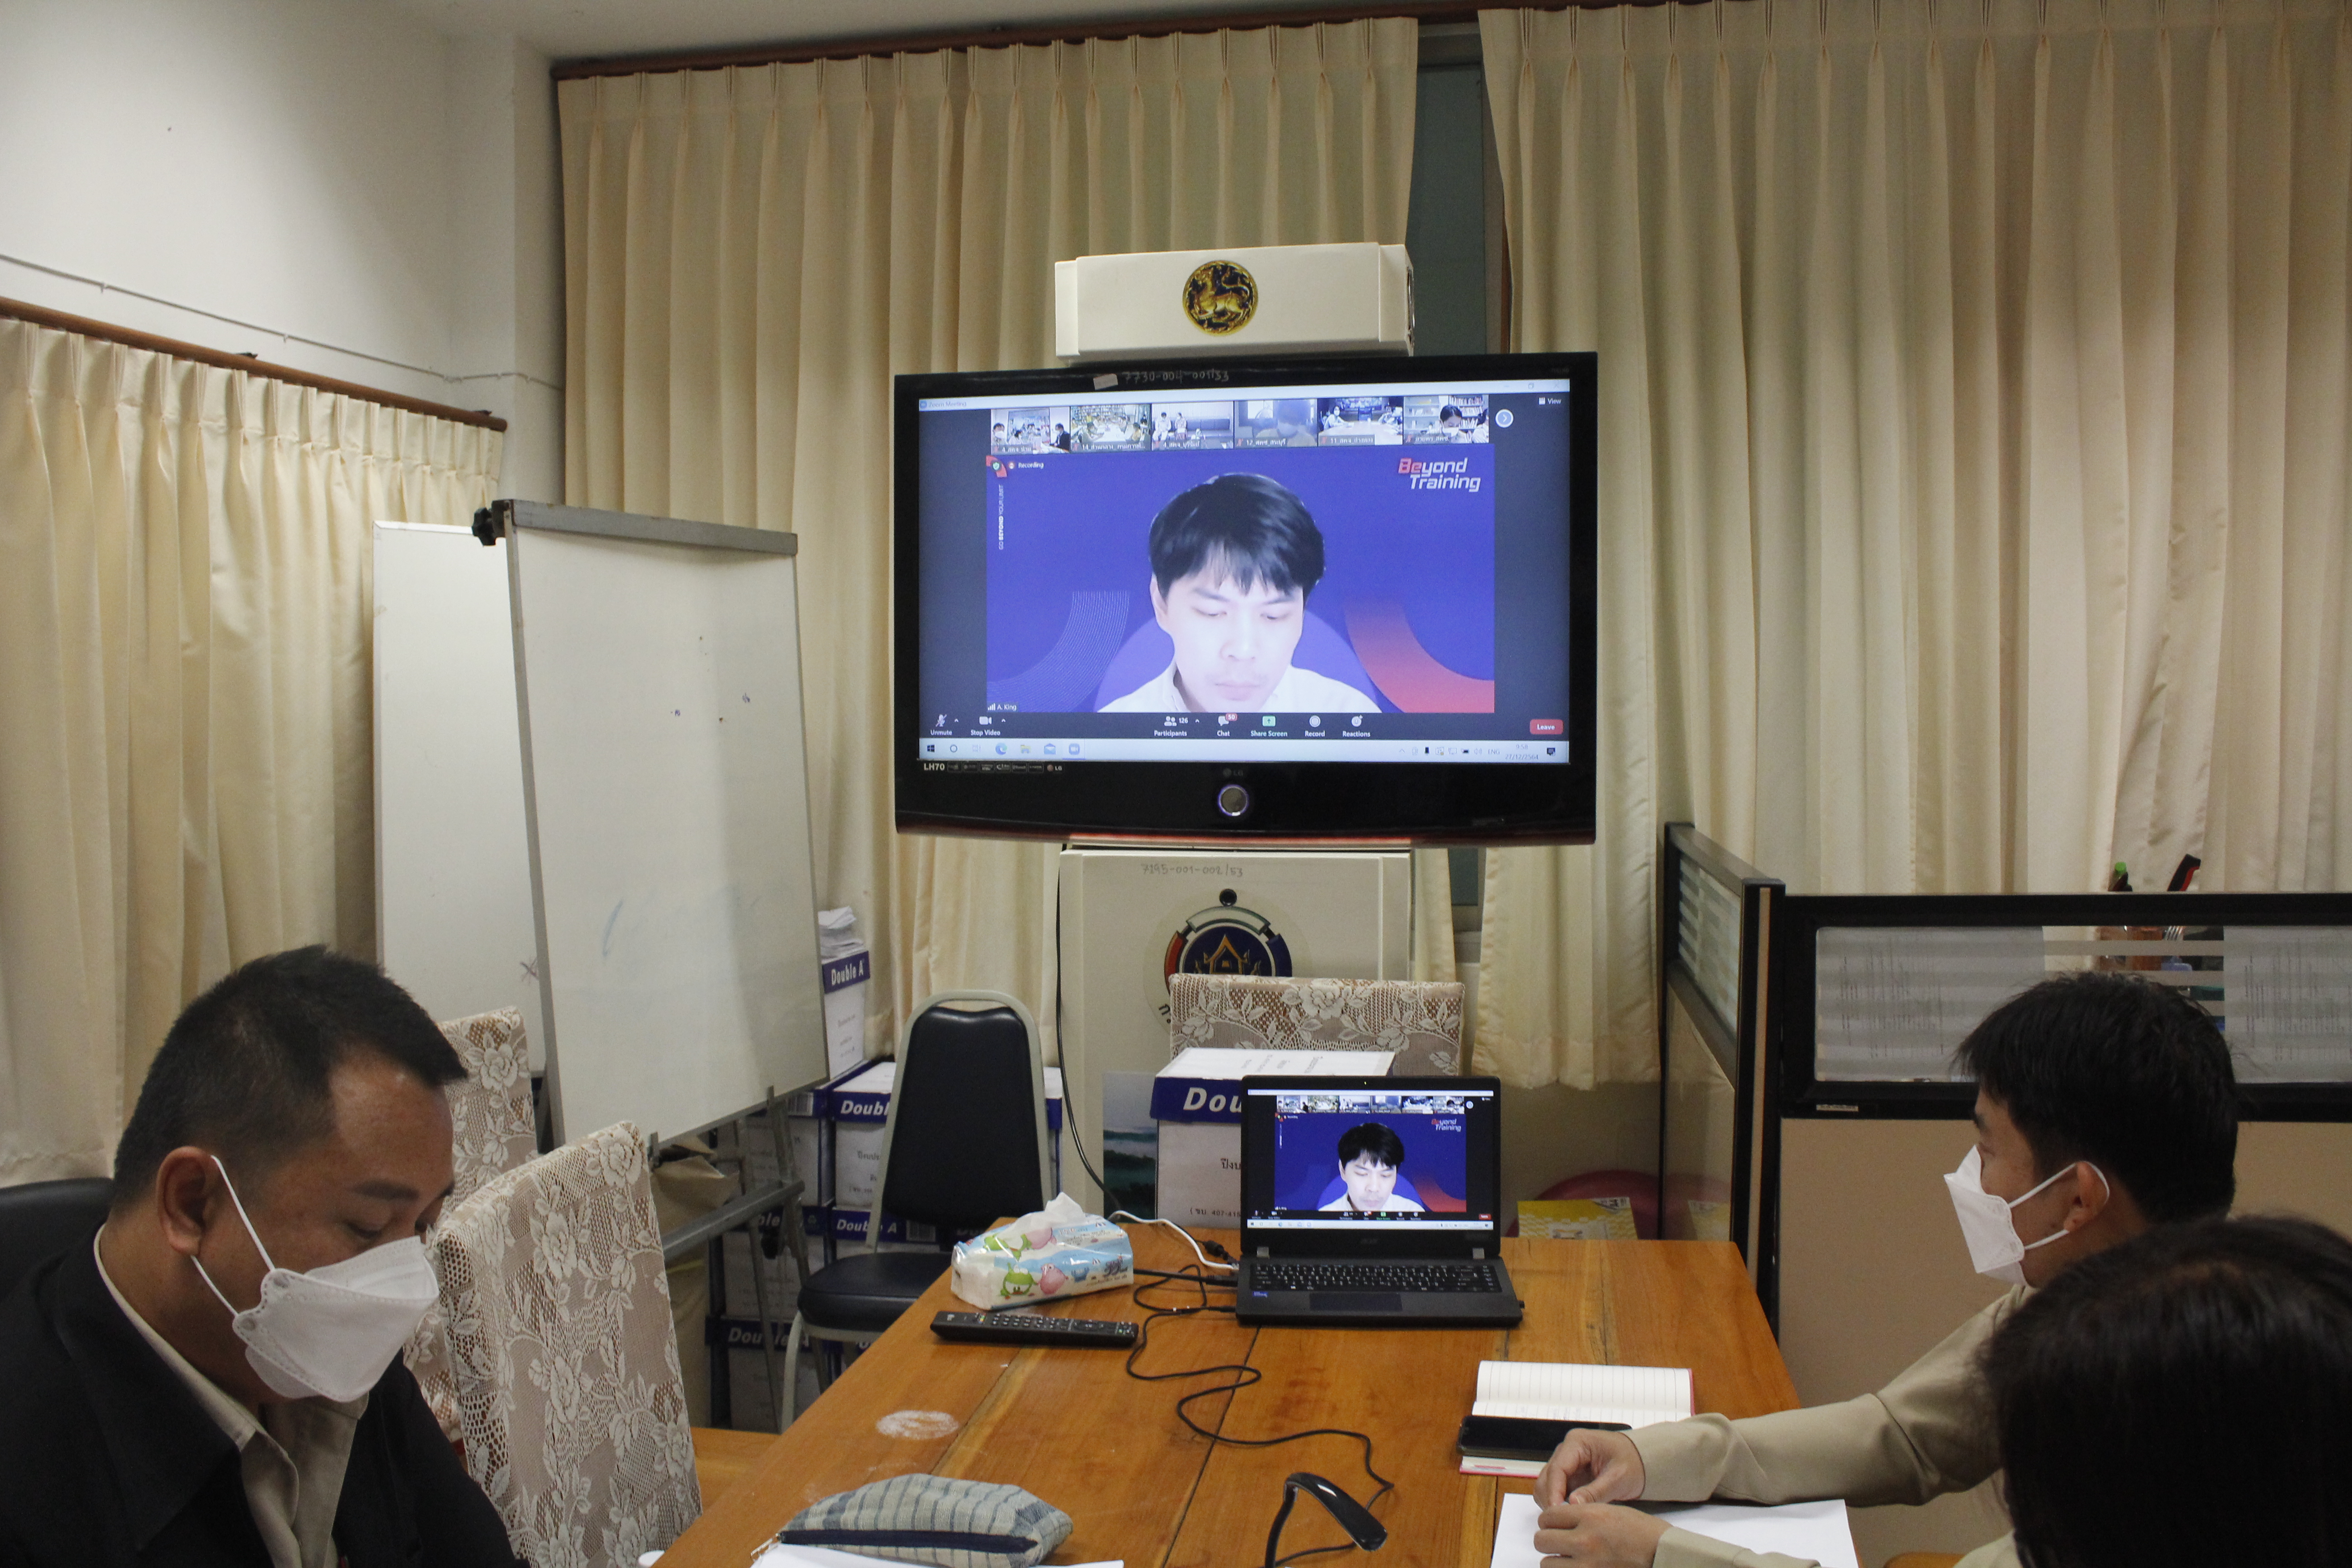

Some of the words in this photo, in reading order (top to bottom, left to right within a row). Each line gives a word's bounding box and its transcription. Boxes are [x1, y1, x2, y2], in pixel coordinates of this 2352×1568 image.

[1398, 457, 1468, 478] Beyond
[1410, 474, 1481, 493] Training
[998, 541, 1004, 550] GO
[831, 963, 857, 986] Double
[858, 960, 864, 977] A
[840, 1100, 890, 1116] Doubl
[1183, 1087, 1241, 1113] Dou
[1436, 1124, 1461, 1132] Training
[837, 1219, 882, 1232] Doub
[887, 1222, 897, 1233] A
[728, 1327, 789, 1346] Doule
